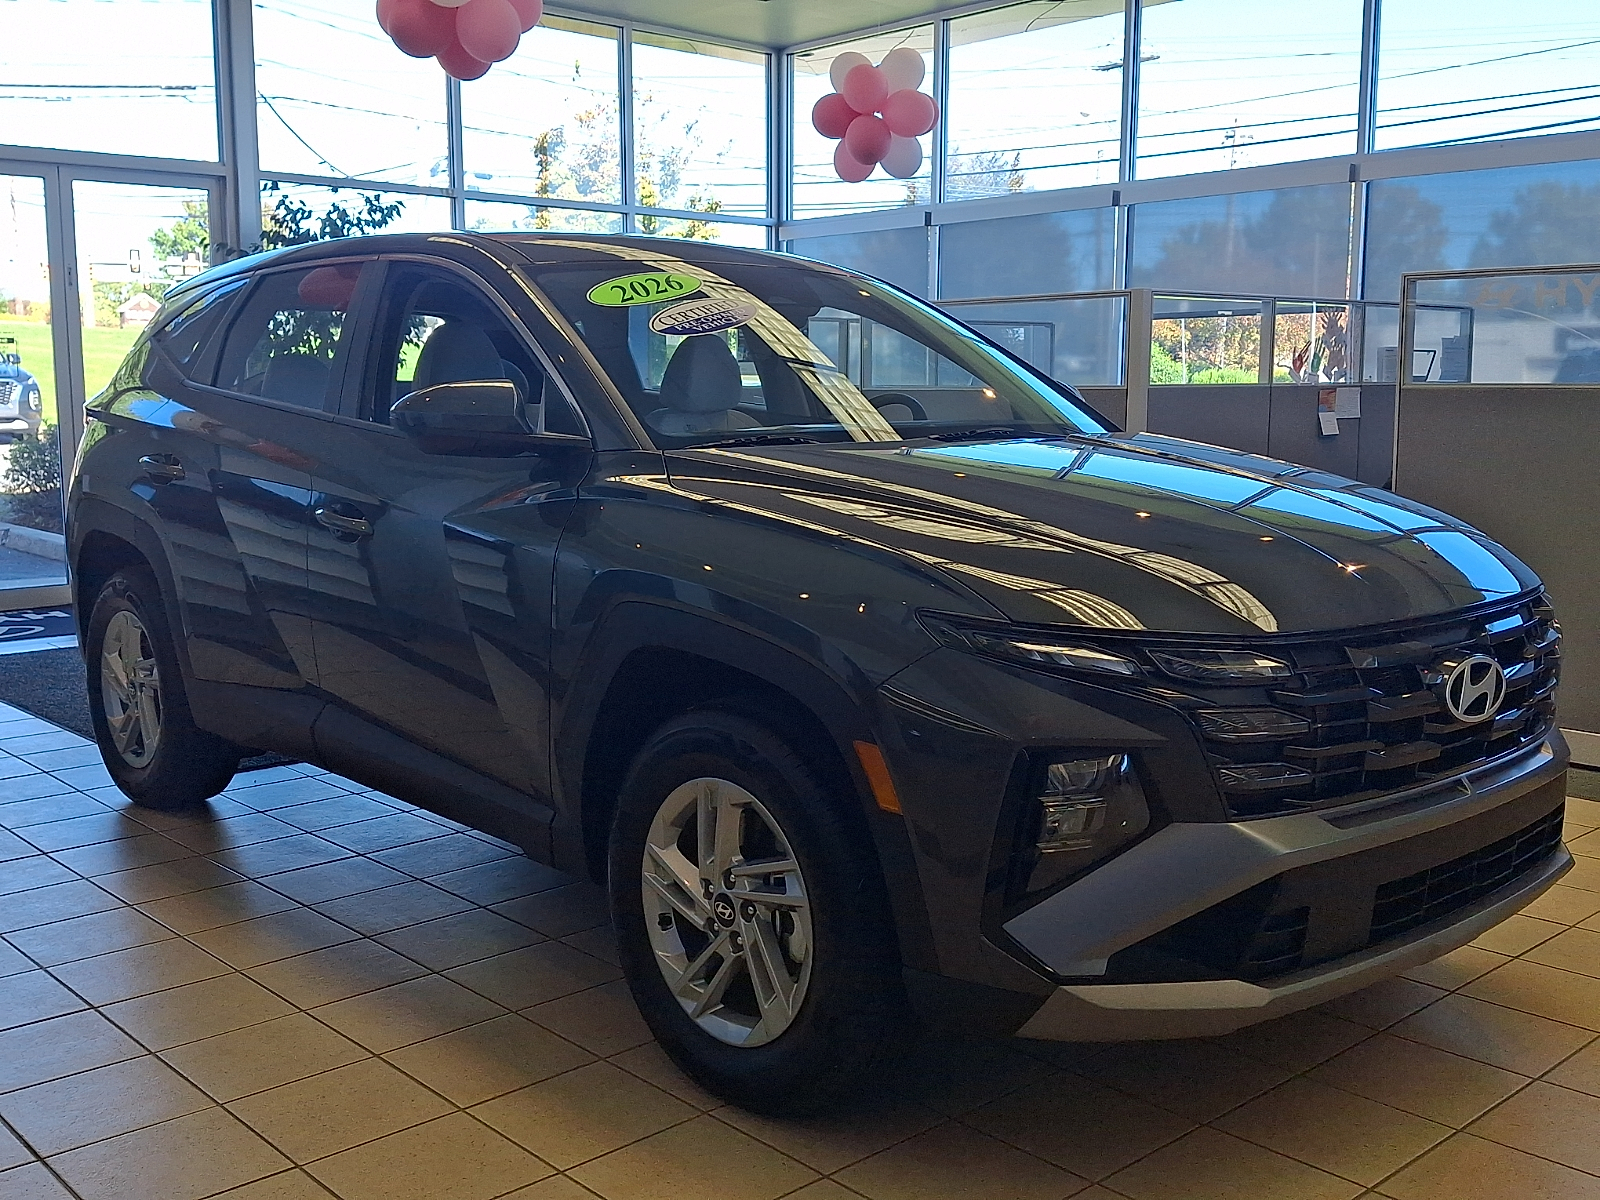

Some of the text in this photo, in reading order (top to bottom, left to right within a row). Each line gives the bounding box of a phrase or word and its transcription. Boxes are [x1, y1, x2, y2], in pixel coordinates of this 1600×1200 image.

[610, 275, 684, 303] 2026
[658, 300, 739, 326] CERTIFIED
[674, 308, 746, 331] PRE-OWNED
